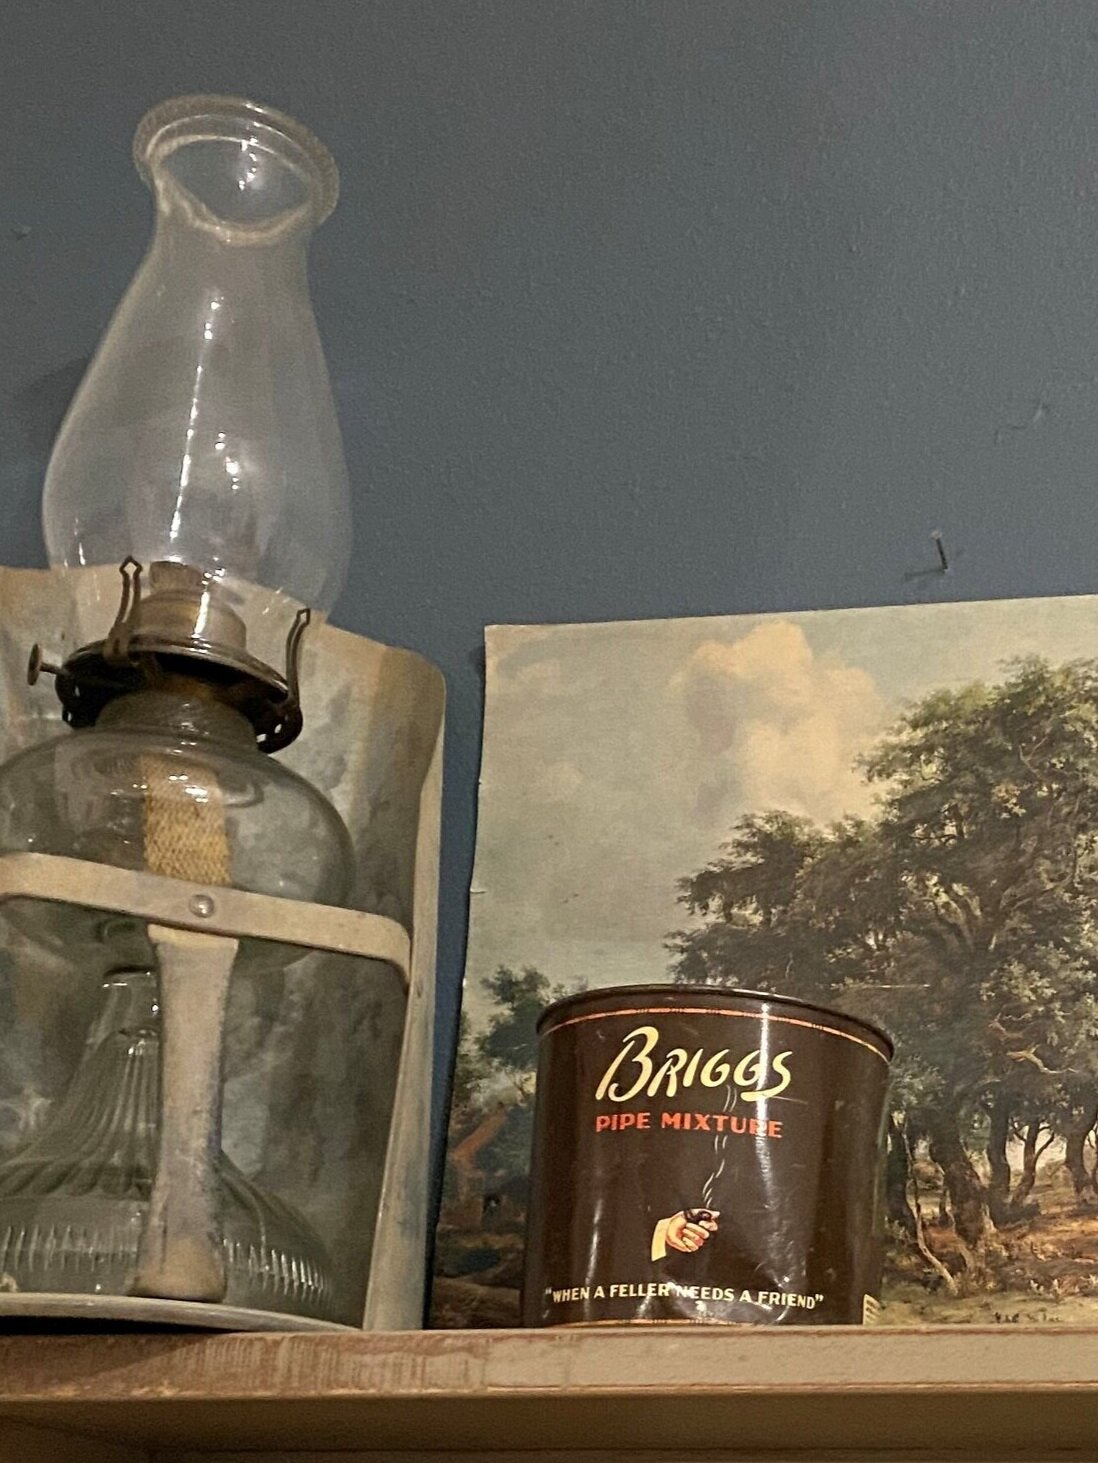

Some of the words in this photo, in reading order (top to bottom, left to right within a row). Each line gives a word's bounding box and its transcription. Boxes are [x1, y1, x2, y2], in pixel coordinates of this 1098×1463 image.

[595, 1026, 793, 1102] BRIGGS
[596, 1112, 651, 1133] PIPE
[661, 1112, 783, 1139] MIXTURE
[593, 1286, 605, 1298] A
[610, 1283, 670, 1297] FELLER
[676, 1285, 734, 1302] NEEDS
[739, 1290, 751, 1302] A
